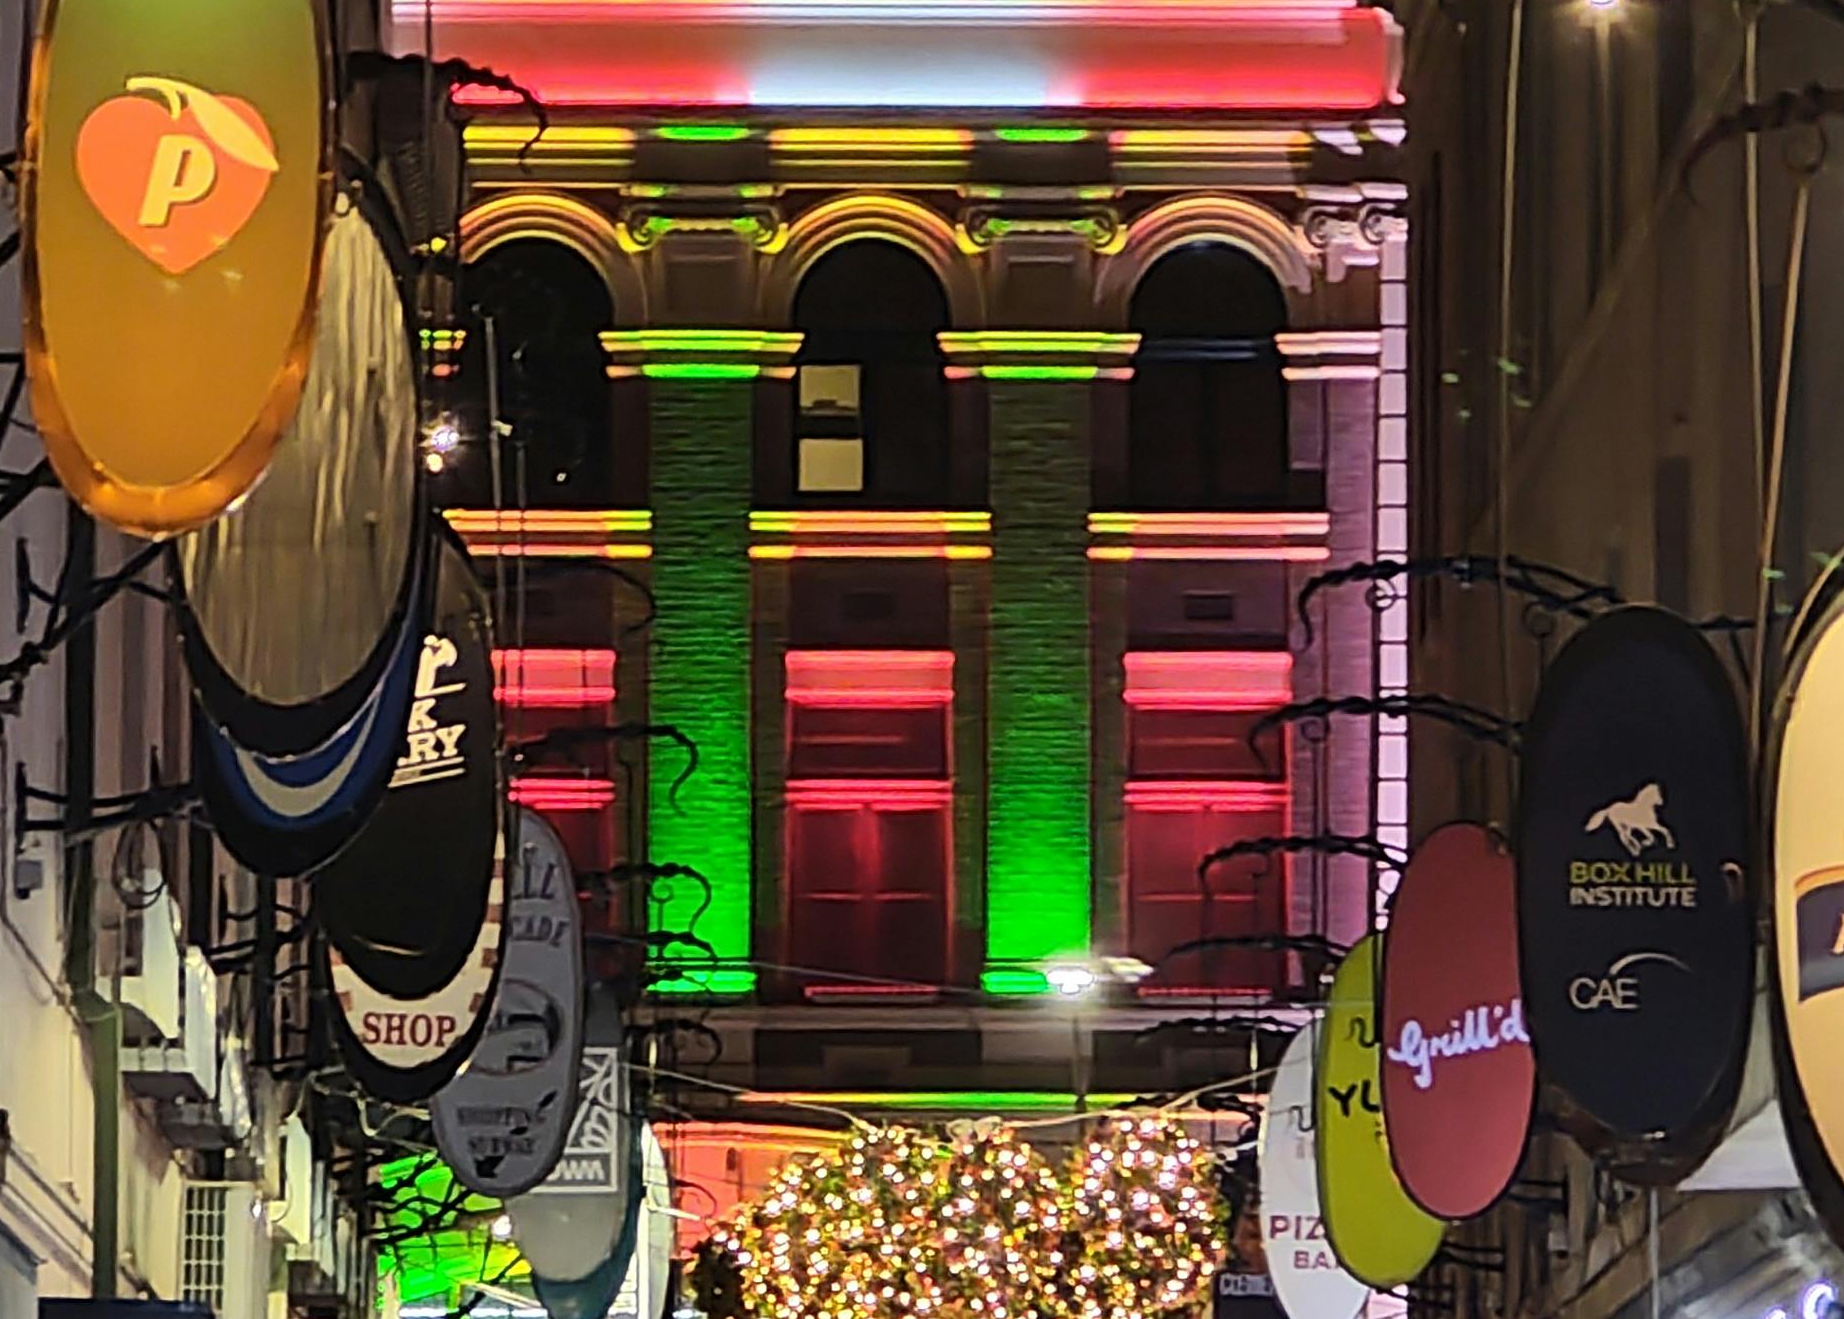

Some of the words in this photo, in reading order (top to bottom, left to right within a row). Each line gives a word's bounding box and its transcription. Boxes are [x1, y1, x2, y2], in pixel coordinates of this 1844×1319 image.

[138, 134, 216, 227] P
[1570, 861, 1631, 883] BOX
[1635, 862, 1697, 884] HILL
[1570, 886, 1697, 907] INSTITUTE
[1569, 977, 1639, 1009] CAE
[361, 1011, 456, 1047] SHOP
[1387, 999, 1530, 1089] Grill'd
[1293, 1250, 1340, 1269] BA
